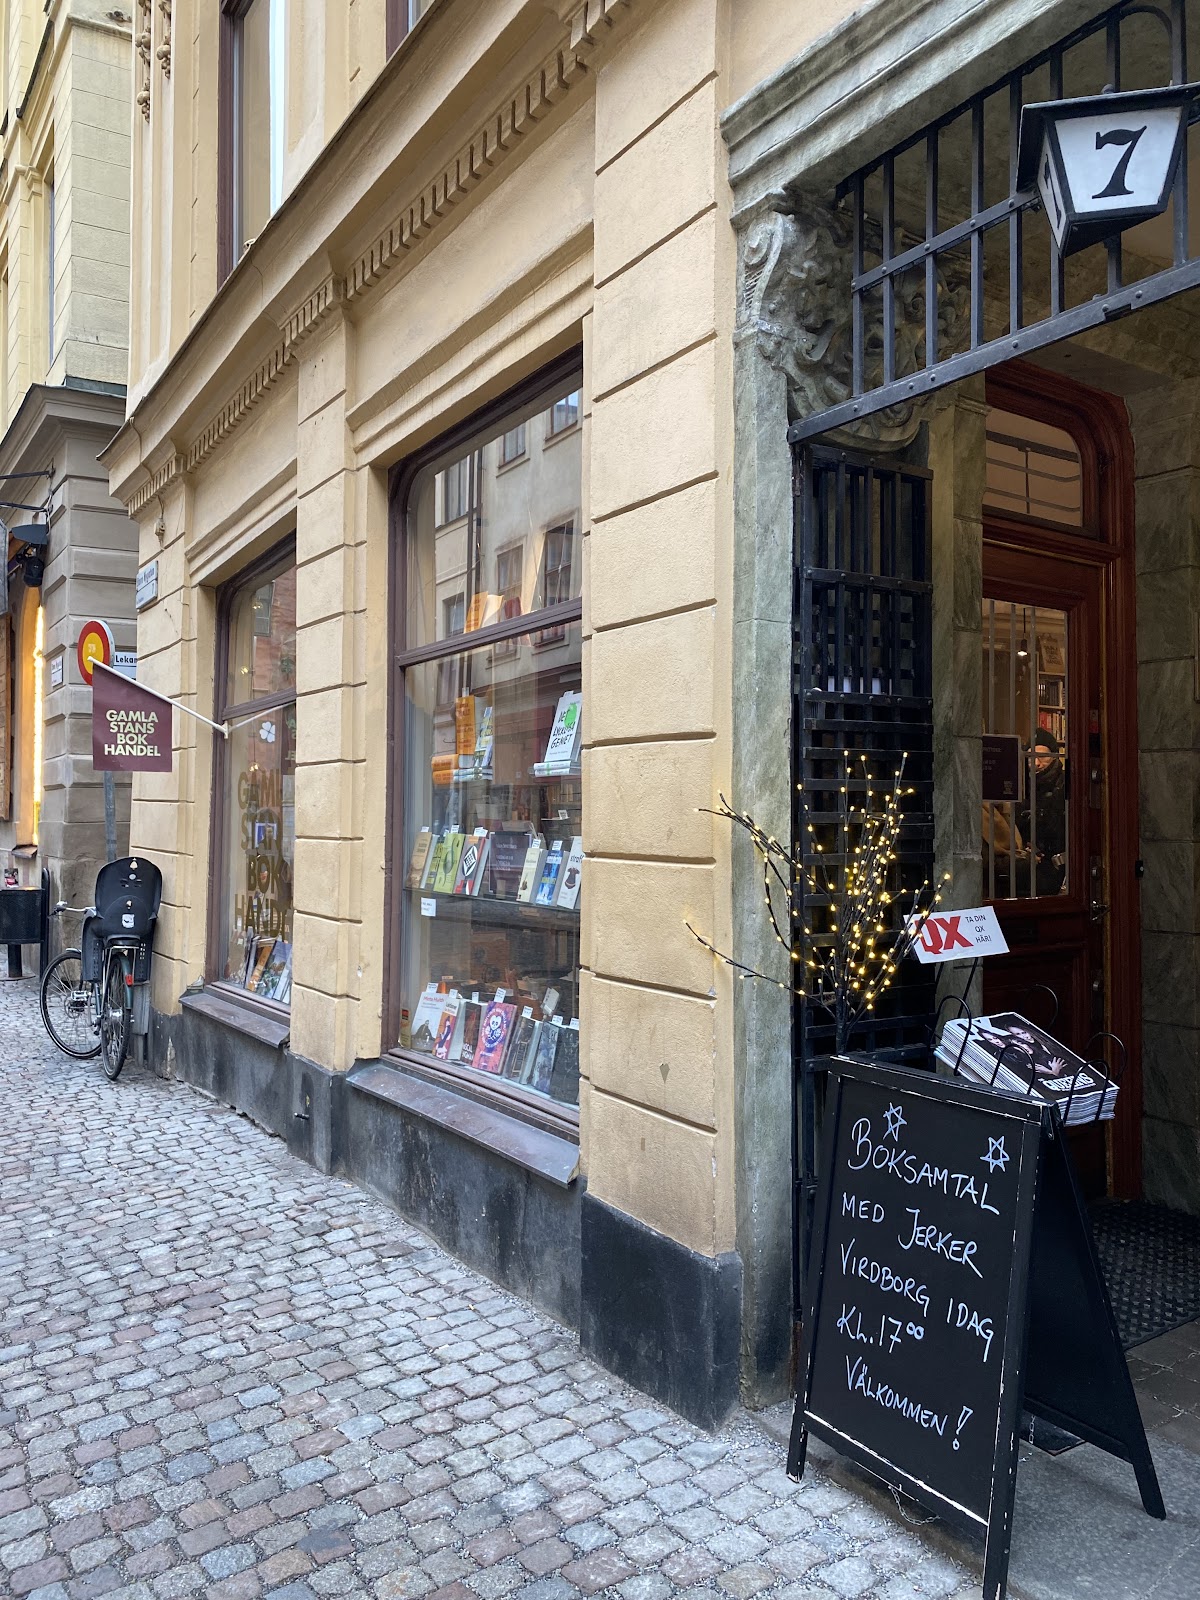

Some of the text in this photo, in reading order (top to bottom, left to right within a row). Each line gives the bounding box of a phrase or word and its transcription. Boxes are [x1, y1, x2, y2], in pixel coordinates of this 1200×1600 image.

[1092, 126, 1147, 199] 7
[1043, 153, 1062, 230] 7
[106, 709, 158, 723] GAMLA
[109, 721, 155, 734] STANS
[104, 743, 161, 757] HANDEL
[116, 733, 148, 745] BOK
[247, 854, 283, 894] BOK
[974, 914, 987, 922] DIN
[975, 925, 985, 933] QX
[914, 914, 975, 955] QX
[975, 935, 992, 943] HÄR!
[848, 1117, 1000, 1216] BOKSAMTAL
[841, 1191, 984, 1279] MED JERKER
[840, 1238, 995, 1363] VIRDBORG IDAG
